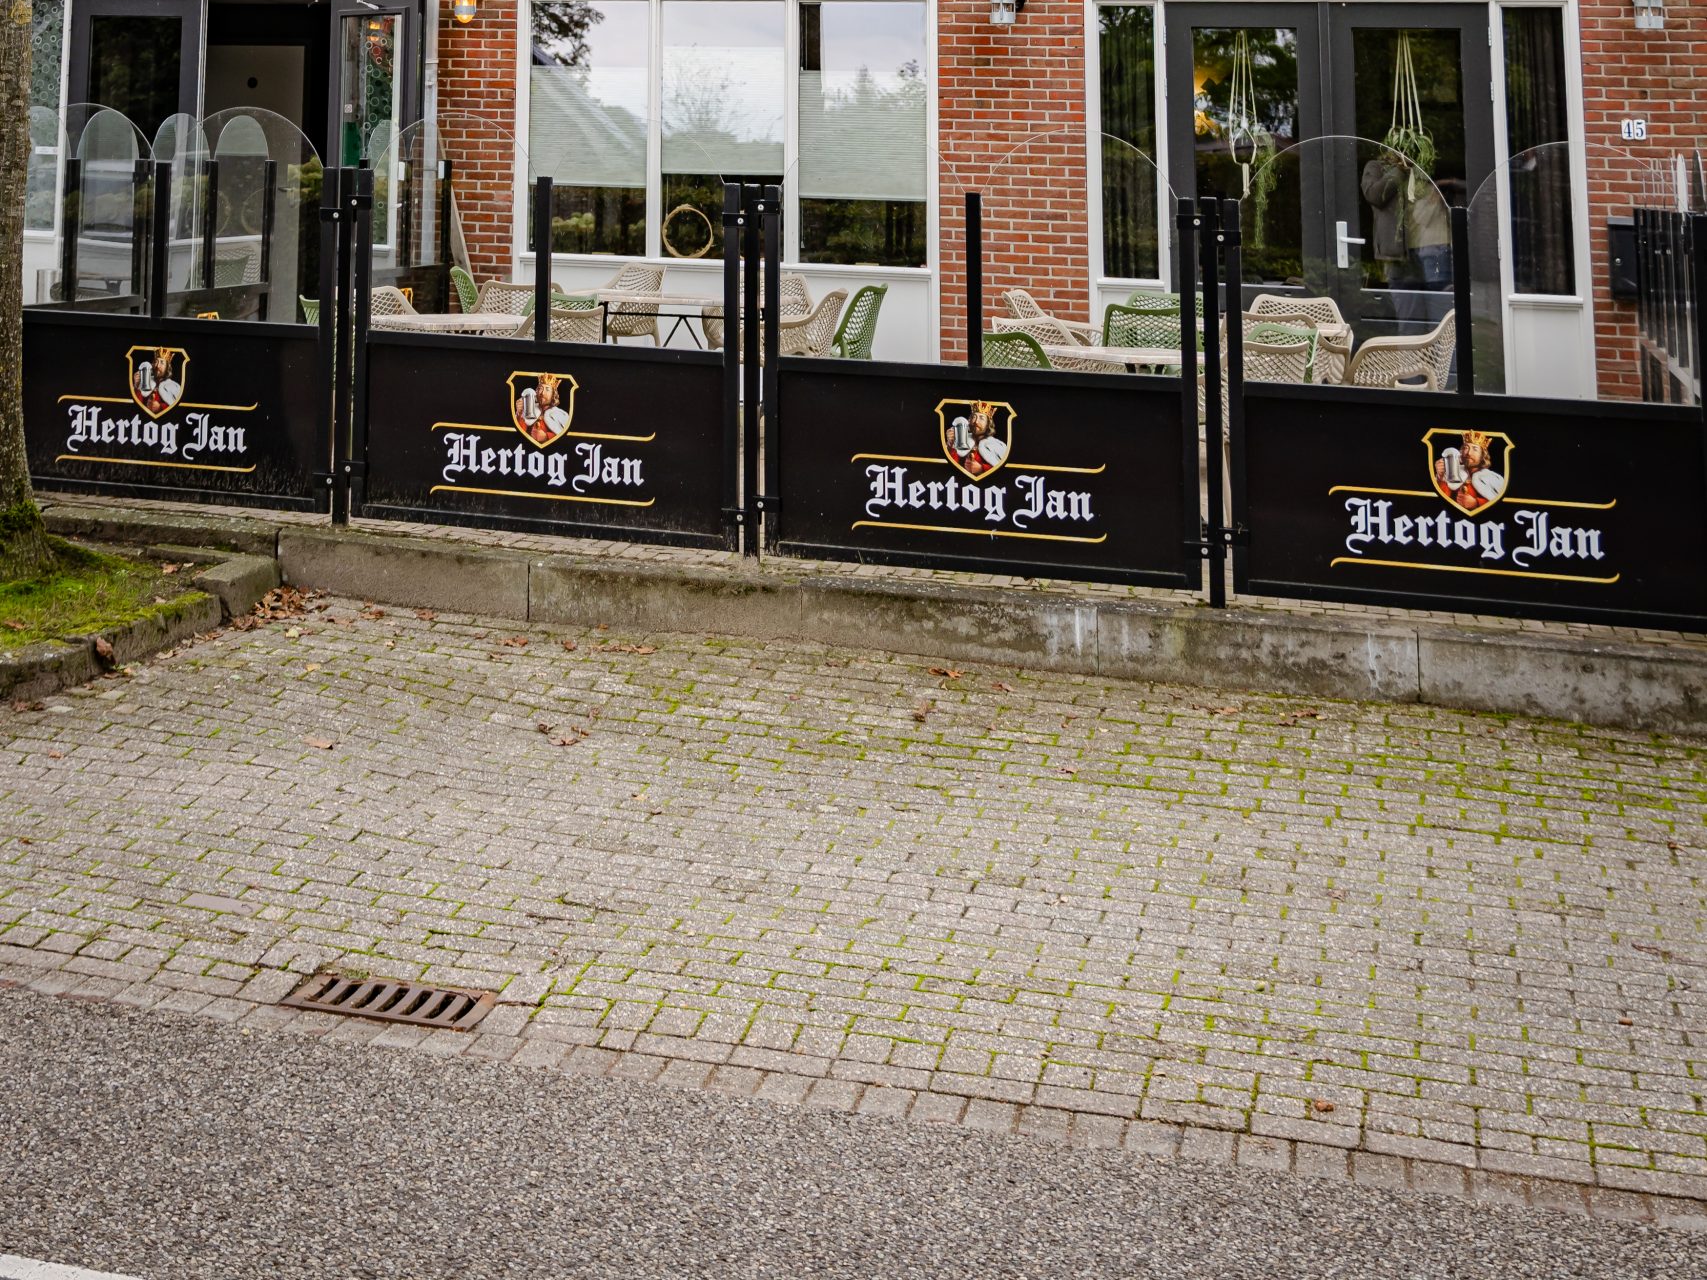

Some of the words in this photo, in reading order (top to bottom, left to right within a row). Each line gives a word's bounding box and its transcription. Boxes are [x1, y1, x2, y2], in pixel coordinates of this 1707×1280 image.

[1624, 121, 1644, 138] 45
[66, 404, 179, 455] Hertog
[182, 412, 247, 461] Jan
[442, 432, 568, 487] Hertog
[572, 442, 645, 493] Jan
[865, 464, 1007, 522] Hertog
[1012, 475, 1094, 529] Jan
[1345, 497, 1505, 560] Hertog
[1512, 510, 1606, 567] Jan
